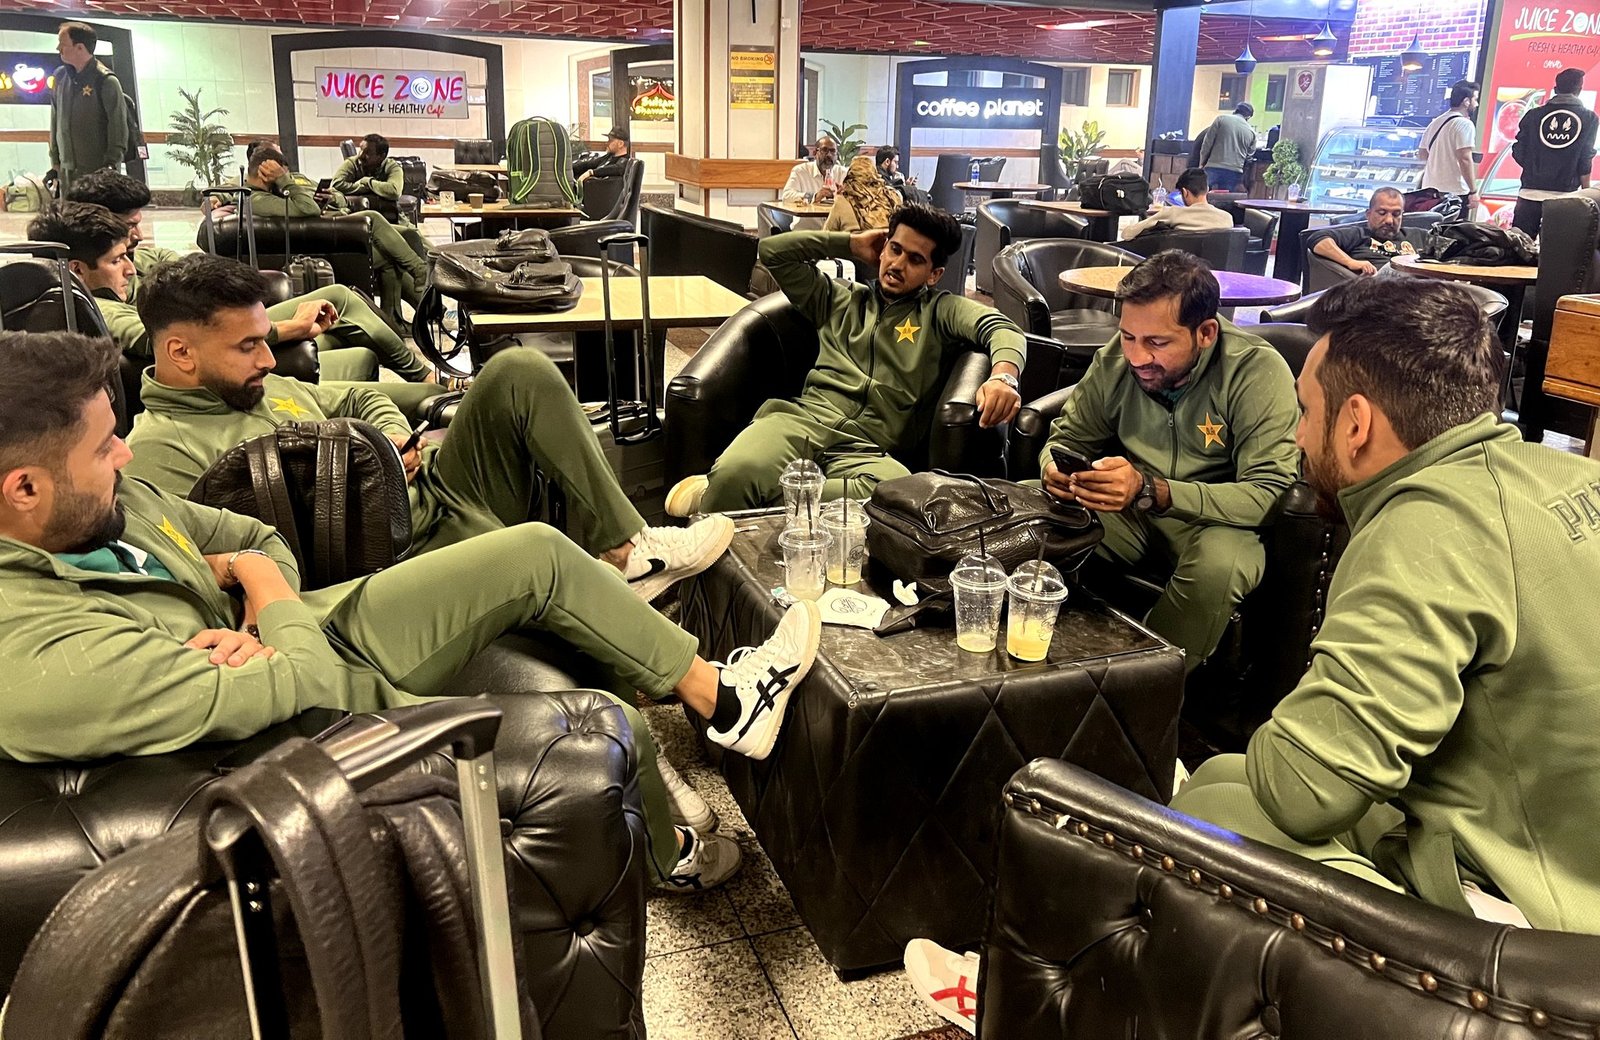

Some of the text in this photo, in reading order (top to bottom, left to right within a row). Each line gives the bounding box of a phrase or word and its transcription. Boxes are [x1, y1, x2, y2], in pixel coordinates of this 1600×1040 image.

[1515, 6, 1600, 36] JUICE ZON
[1528, 42, 1550, 53] FRESH
[1558, 43, 1586, 55] HEALTHY
[321, 72, 464, 102] JUICE ZONE
[345, 102, 374, 114] FRESH
[388, 103, 426, 114] HEALTHY
[917, 98, 1044, 119] coffee planet
